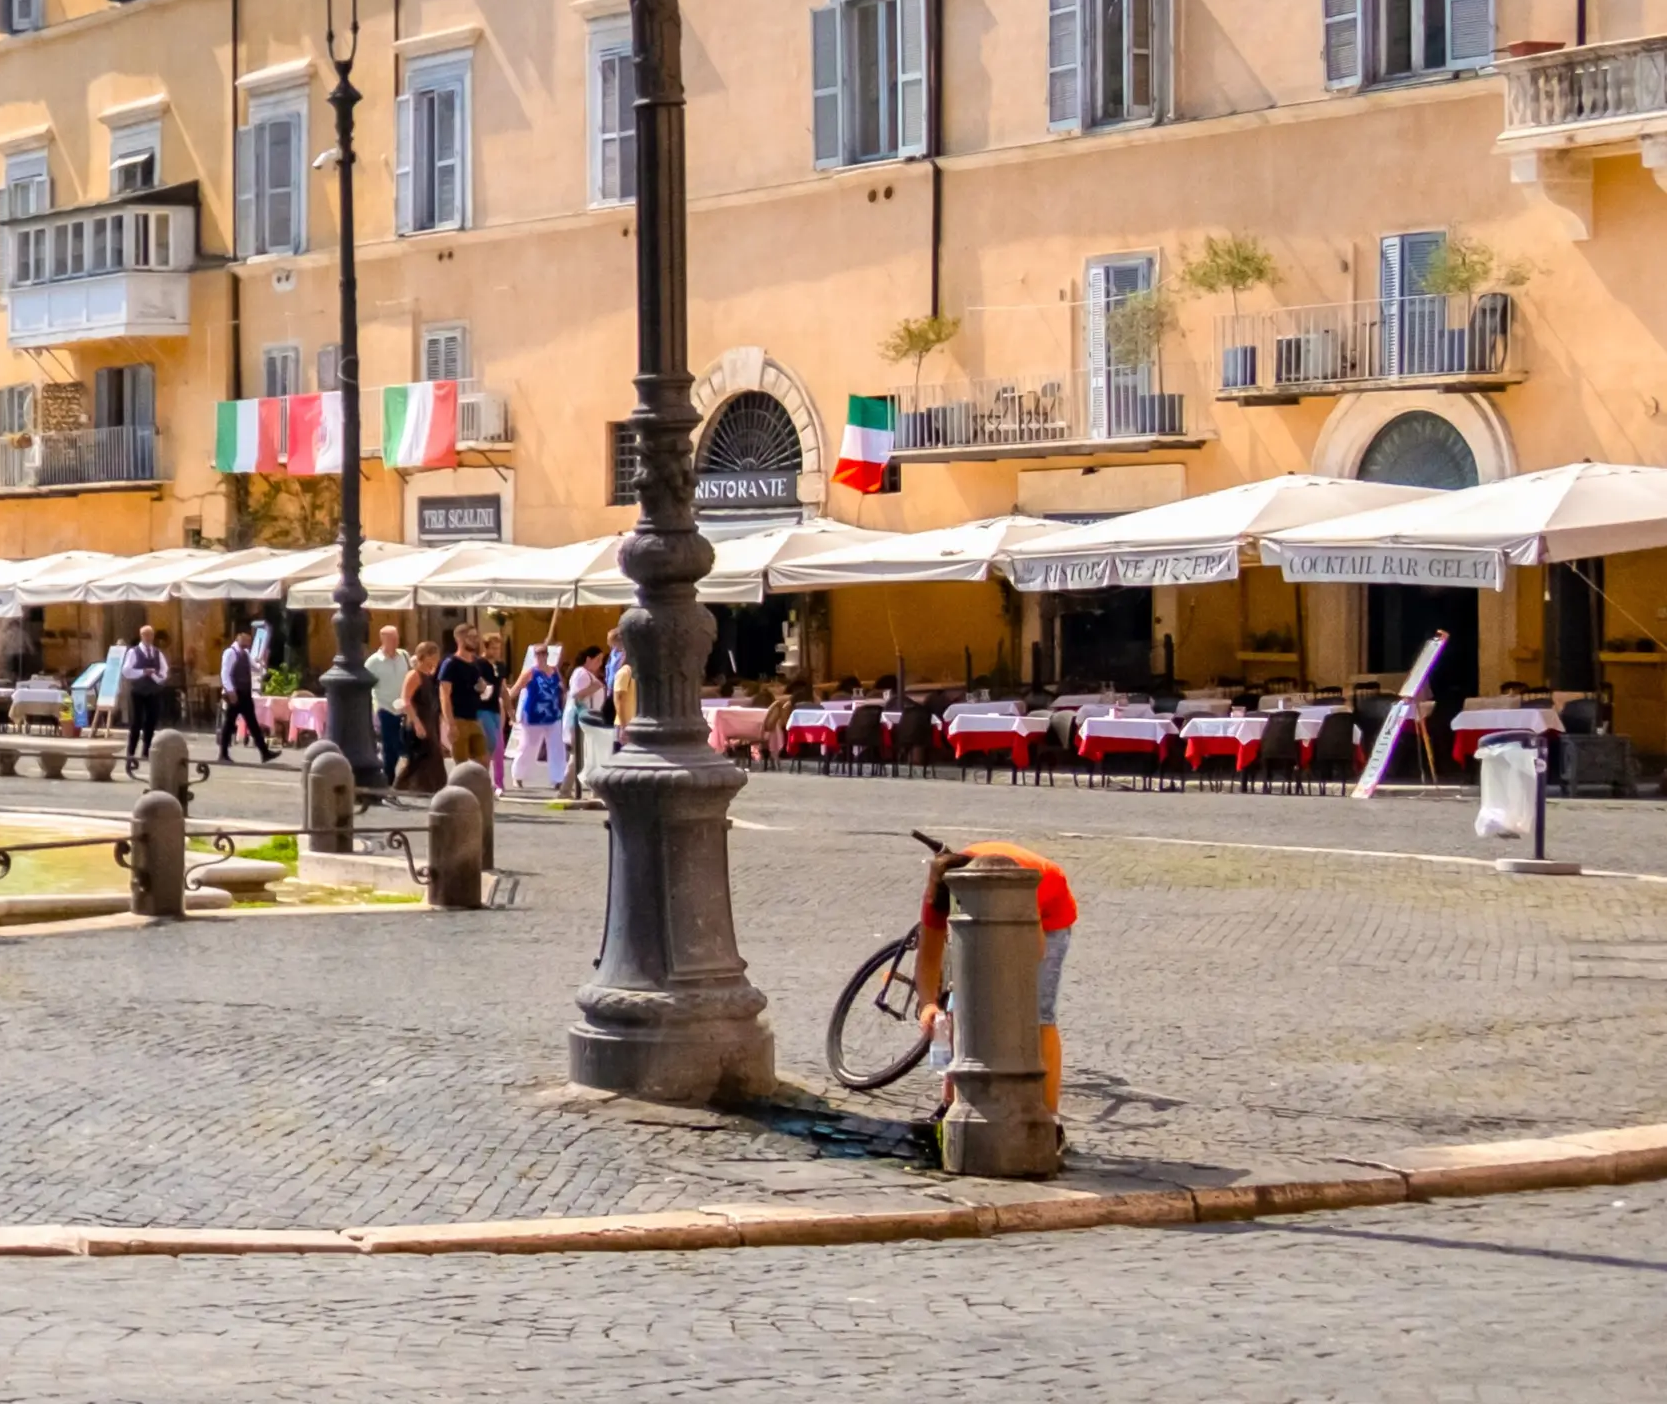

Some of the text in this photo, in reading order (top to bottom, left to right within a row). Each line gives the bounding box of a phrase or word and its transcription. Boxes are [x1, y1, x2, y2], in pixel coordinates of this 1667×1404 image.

[695, 478, 787, 499] RISTORANTE
[423, 508, 494, 528] TRE SCALINI
[1289, 555, 1377, 575] COCKTAIL
[1382, 556, 1418, 577] BAR
